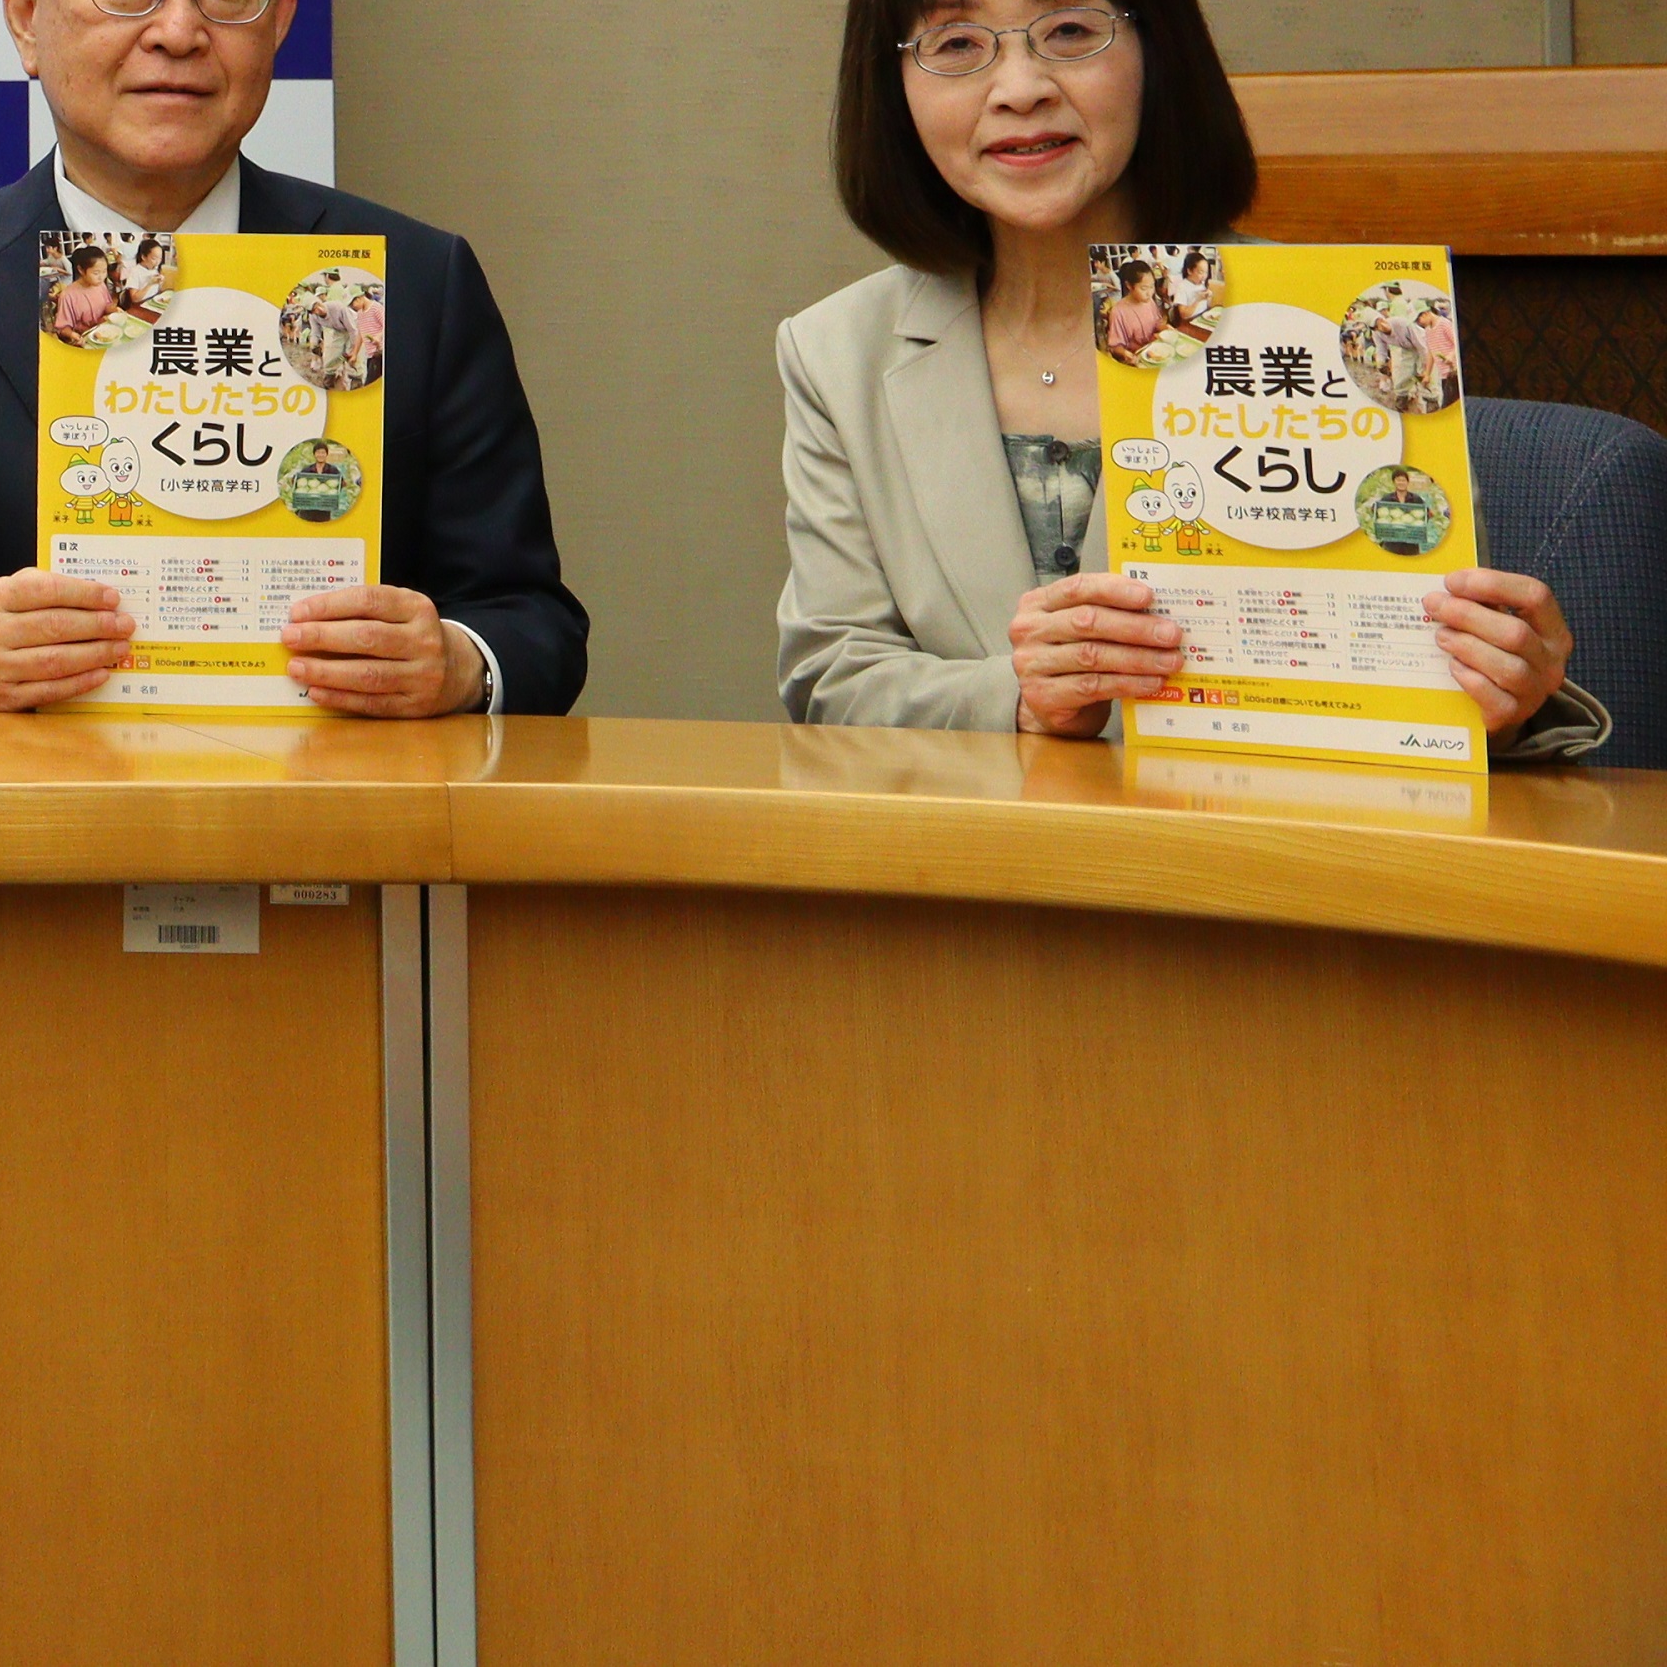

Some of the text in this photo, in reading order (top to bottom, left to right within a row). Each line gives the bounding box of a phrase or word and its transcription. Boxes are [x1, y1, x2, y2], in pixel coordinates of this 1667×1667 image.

[318, 249, 371, 259] 2026年度版
[1374, 261, 1432, 272] 2026年度版
[149, 326, 282, 377] 農業と
[1205, 345, 1348, 398] 農業と
[104, 381, 318, 417] わたしたちの
[61, 423, 99, 431] いっしょに
[1162, 402, 1391, 441] わたしたちの
[151, 421, 273, 467] くらし
[1122, 446, 1160, 454] いっしょに
[1213, 445, 1346, 494] くらし
[59, 542, 79, 551] 目次
[1129, 569, 1149, 580] 目次
[122, 684, 158, 694] 組 名前
[1212, 721, 1222, 731] 組
[1231, 722, 1250, 733] 名前
[1423, 738, 1465, 751] JAバンク
